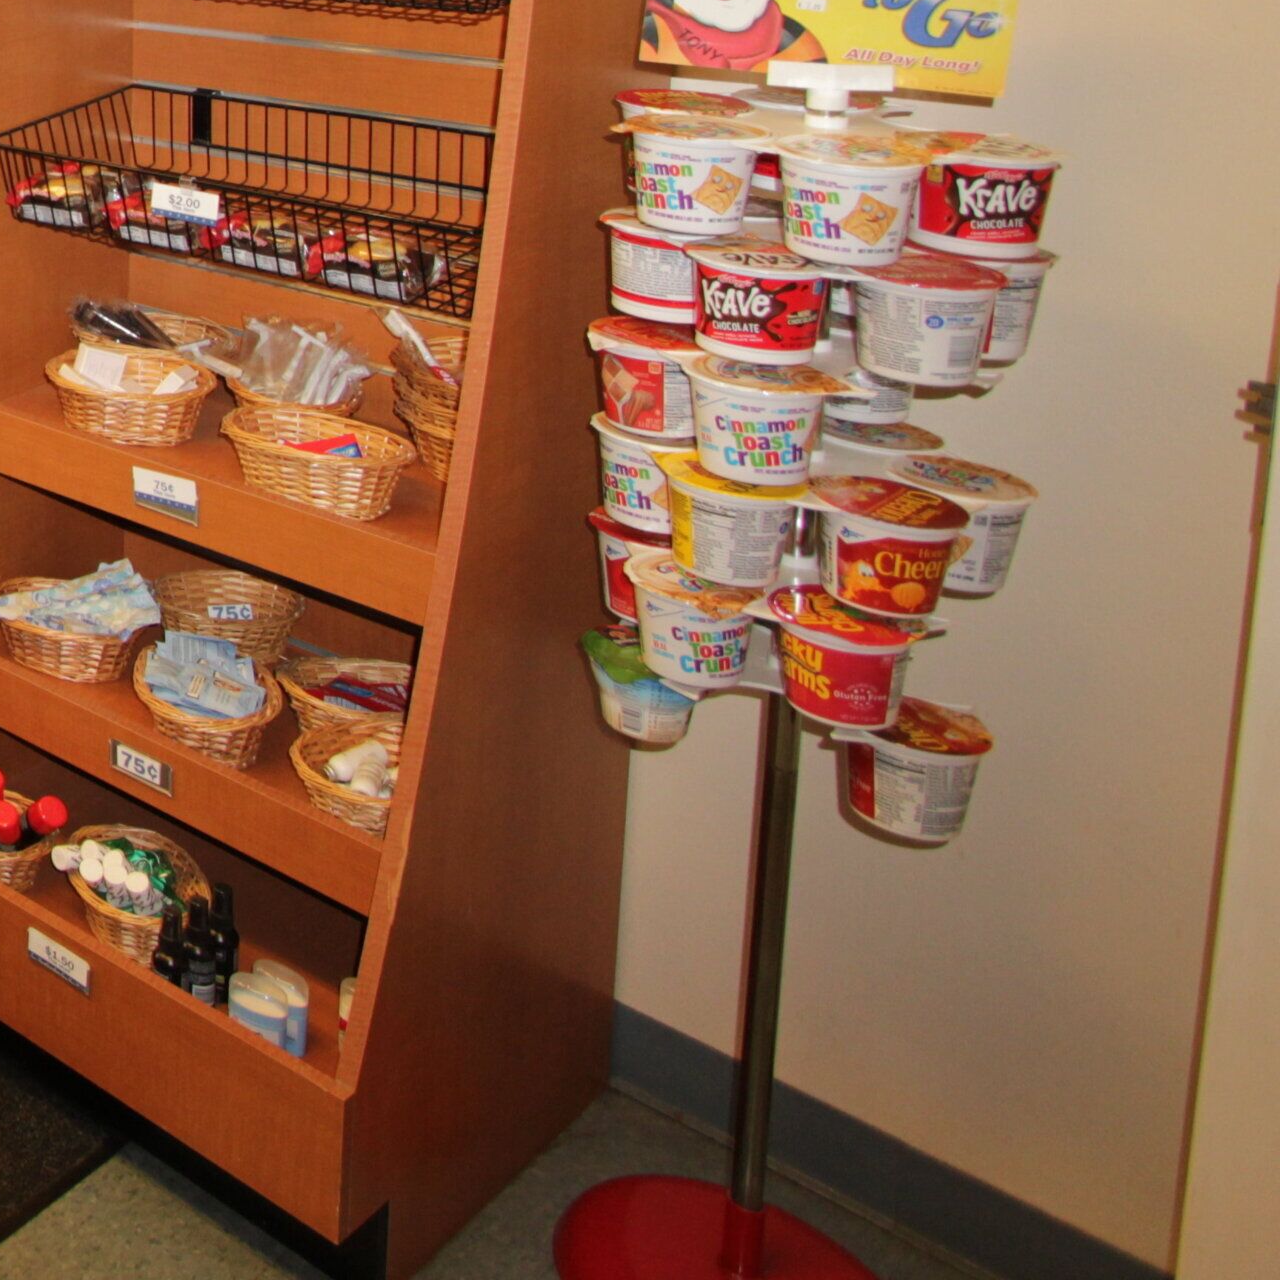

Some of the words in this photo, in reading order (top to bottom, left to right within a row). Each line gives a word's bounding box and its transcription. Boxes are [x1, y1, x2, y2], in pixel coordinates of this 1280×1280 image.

[678, 28, 725, 61] TONY
[845, 47, 875, 61] All
[878, 51, 916, 68] Day
[921, 56, 982, 74] Long!
[640, 173, 677, 193] oast
[169, 194, 201, 209] $2.00
[969, 217, 1025, 230] CHOCOLATE
[712, 320, 761, 334] CHOCOLATE
[715, 415, 806, 433] Cinnamon
[733, 432, 792, 451] Toast
[724, 443, 803, 468] Crunch
[153, 479, 175, 494] 75¢
[211, 604, 252, 620] 75¢
[833, 688, 867, 702] Gluten
[120, 750, 160, 780] 75¢
[45, 945, 75, 971] $1.50
